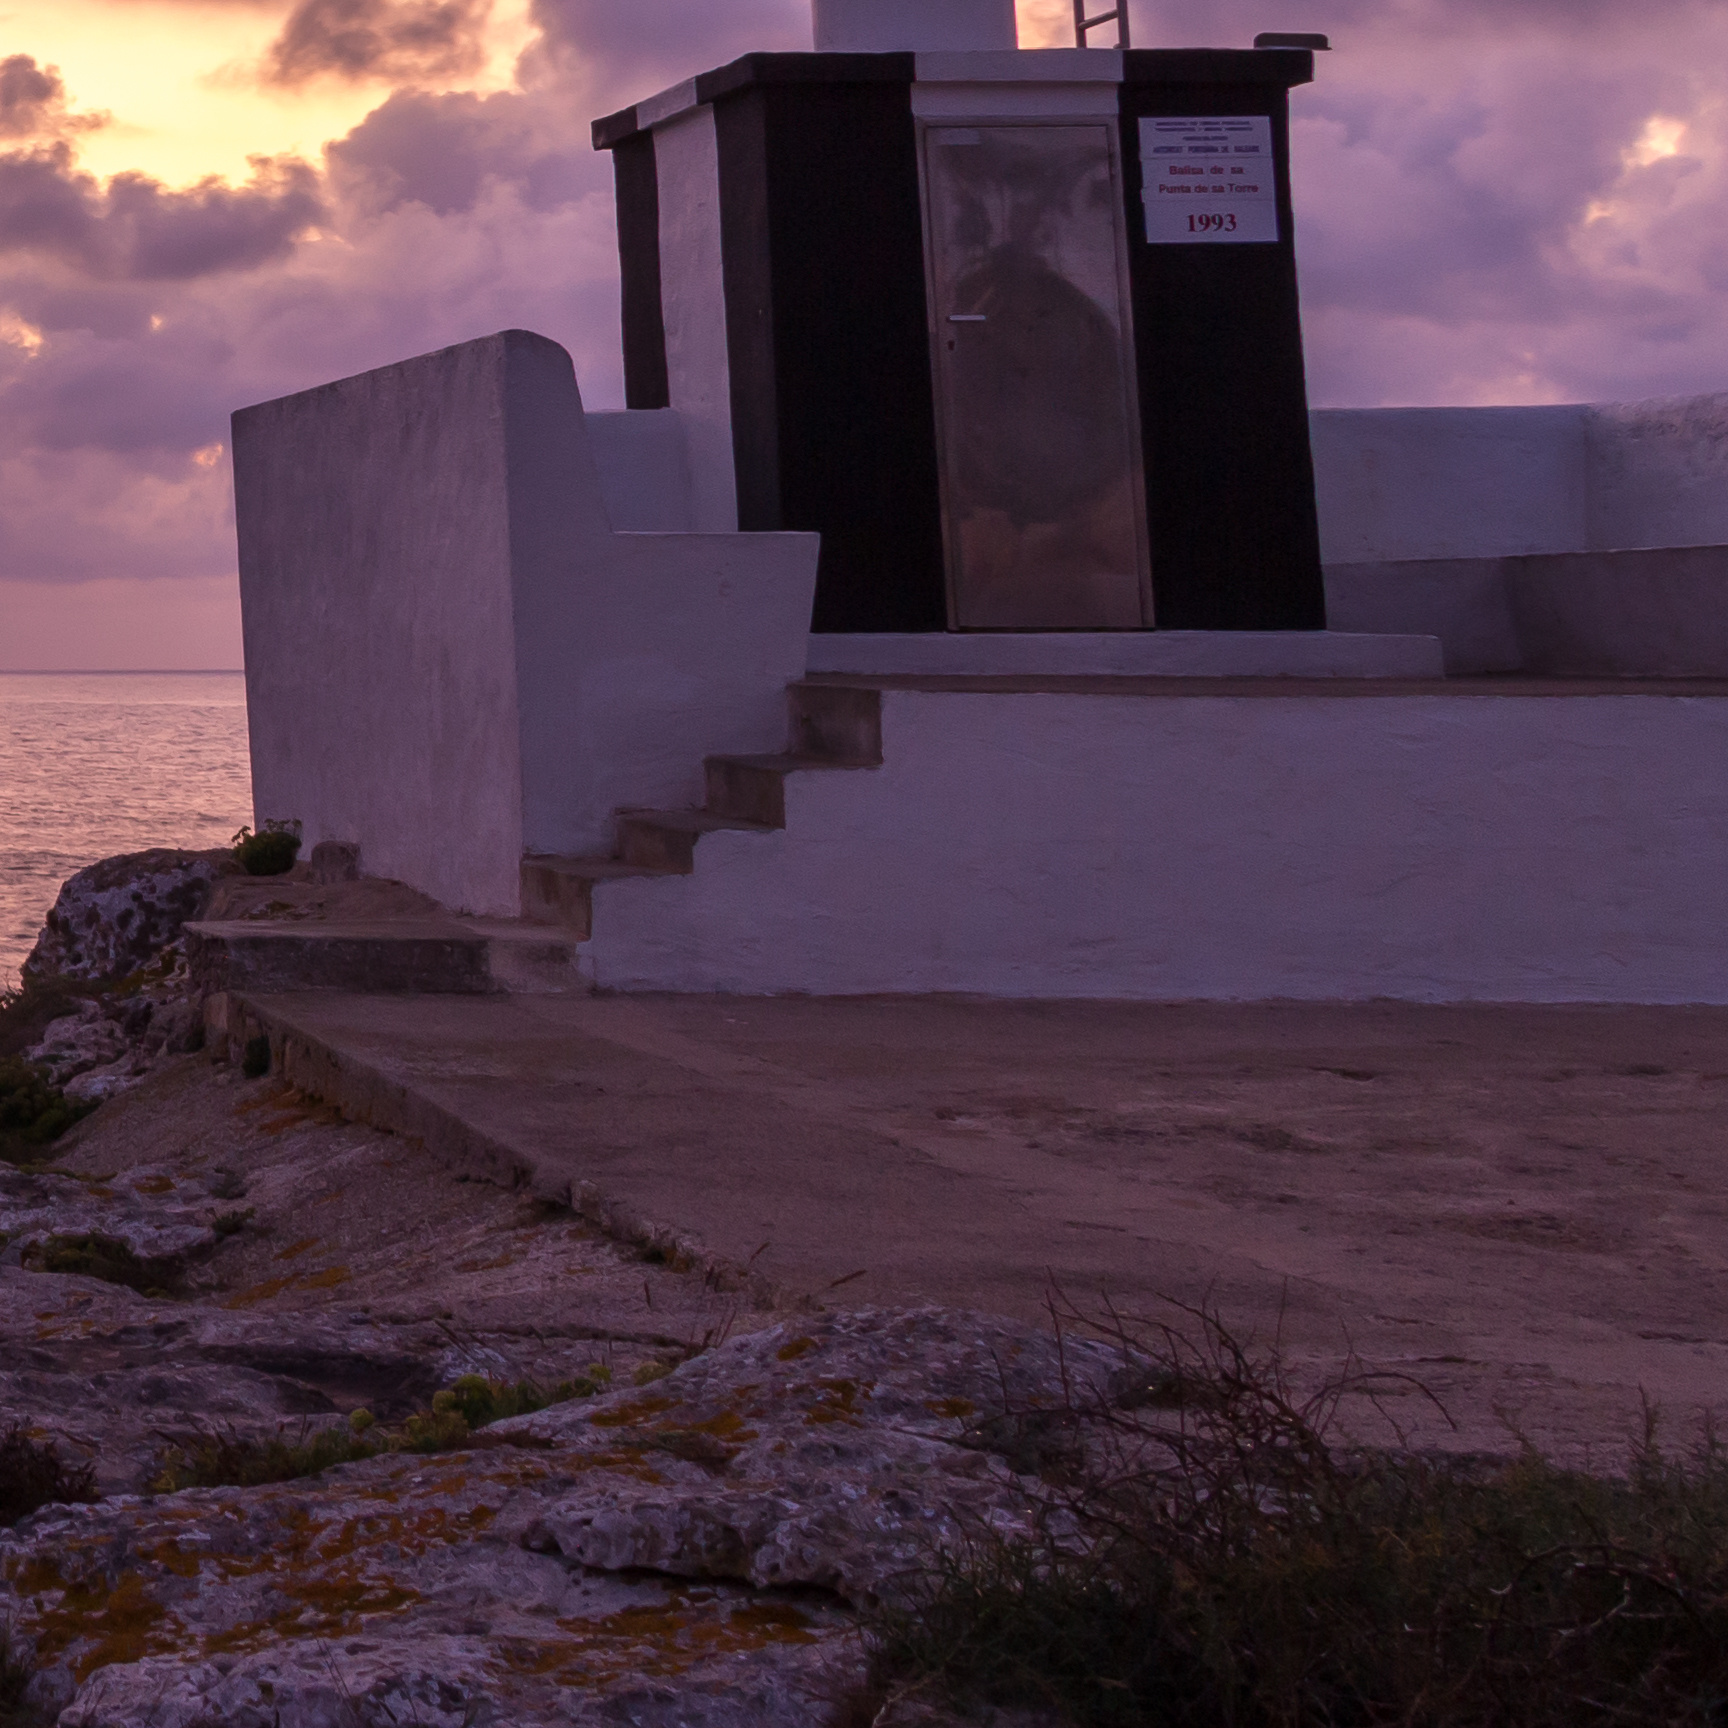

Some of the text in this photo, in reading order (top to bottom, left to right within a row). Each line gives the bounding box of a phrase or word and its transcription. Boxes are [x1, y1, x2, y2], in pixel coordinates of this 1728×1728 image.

[1210, 165, 1224, 175] de
[1230, 166, 1244, 175] sa
[1159, 183, 1259, 194] Punta de sa Torre
[1187, 213, 1237, 233] 1993
